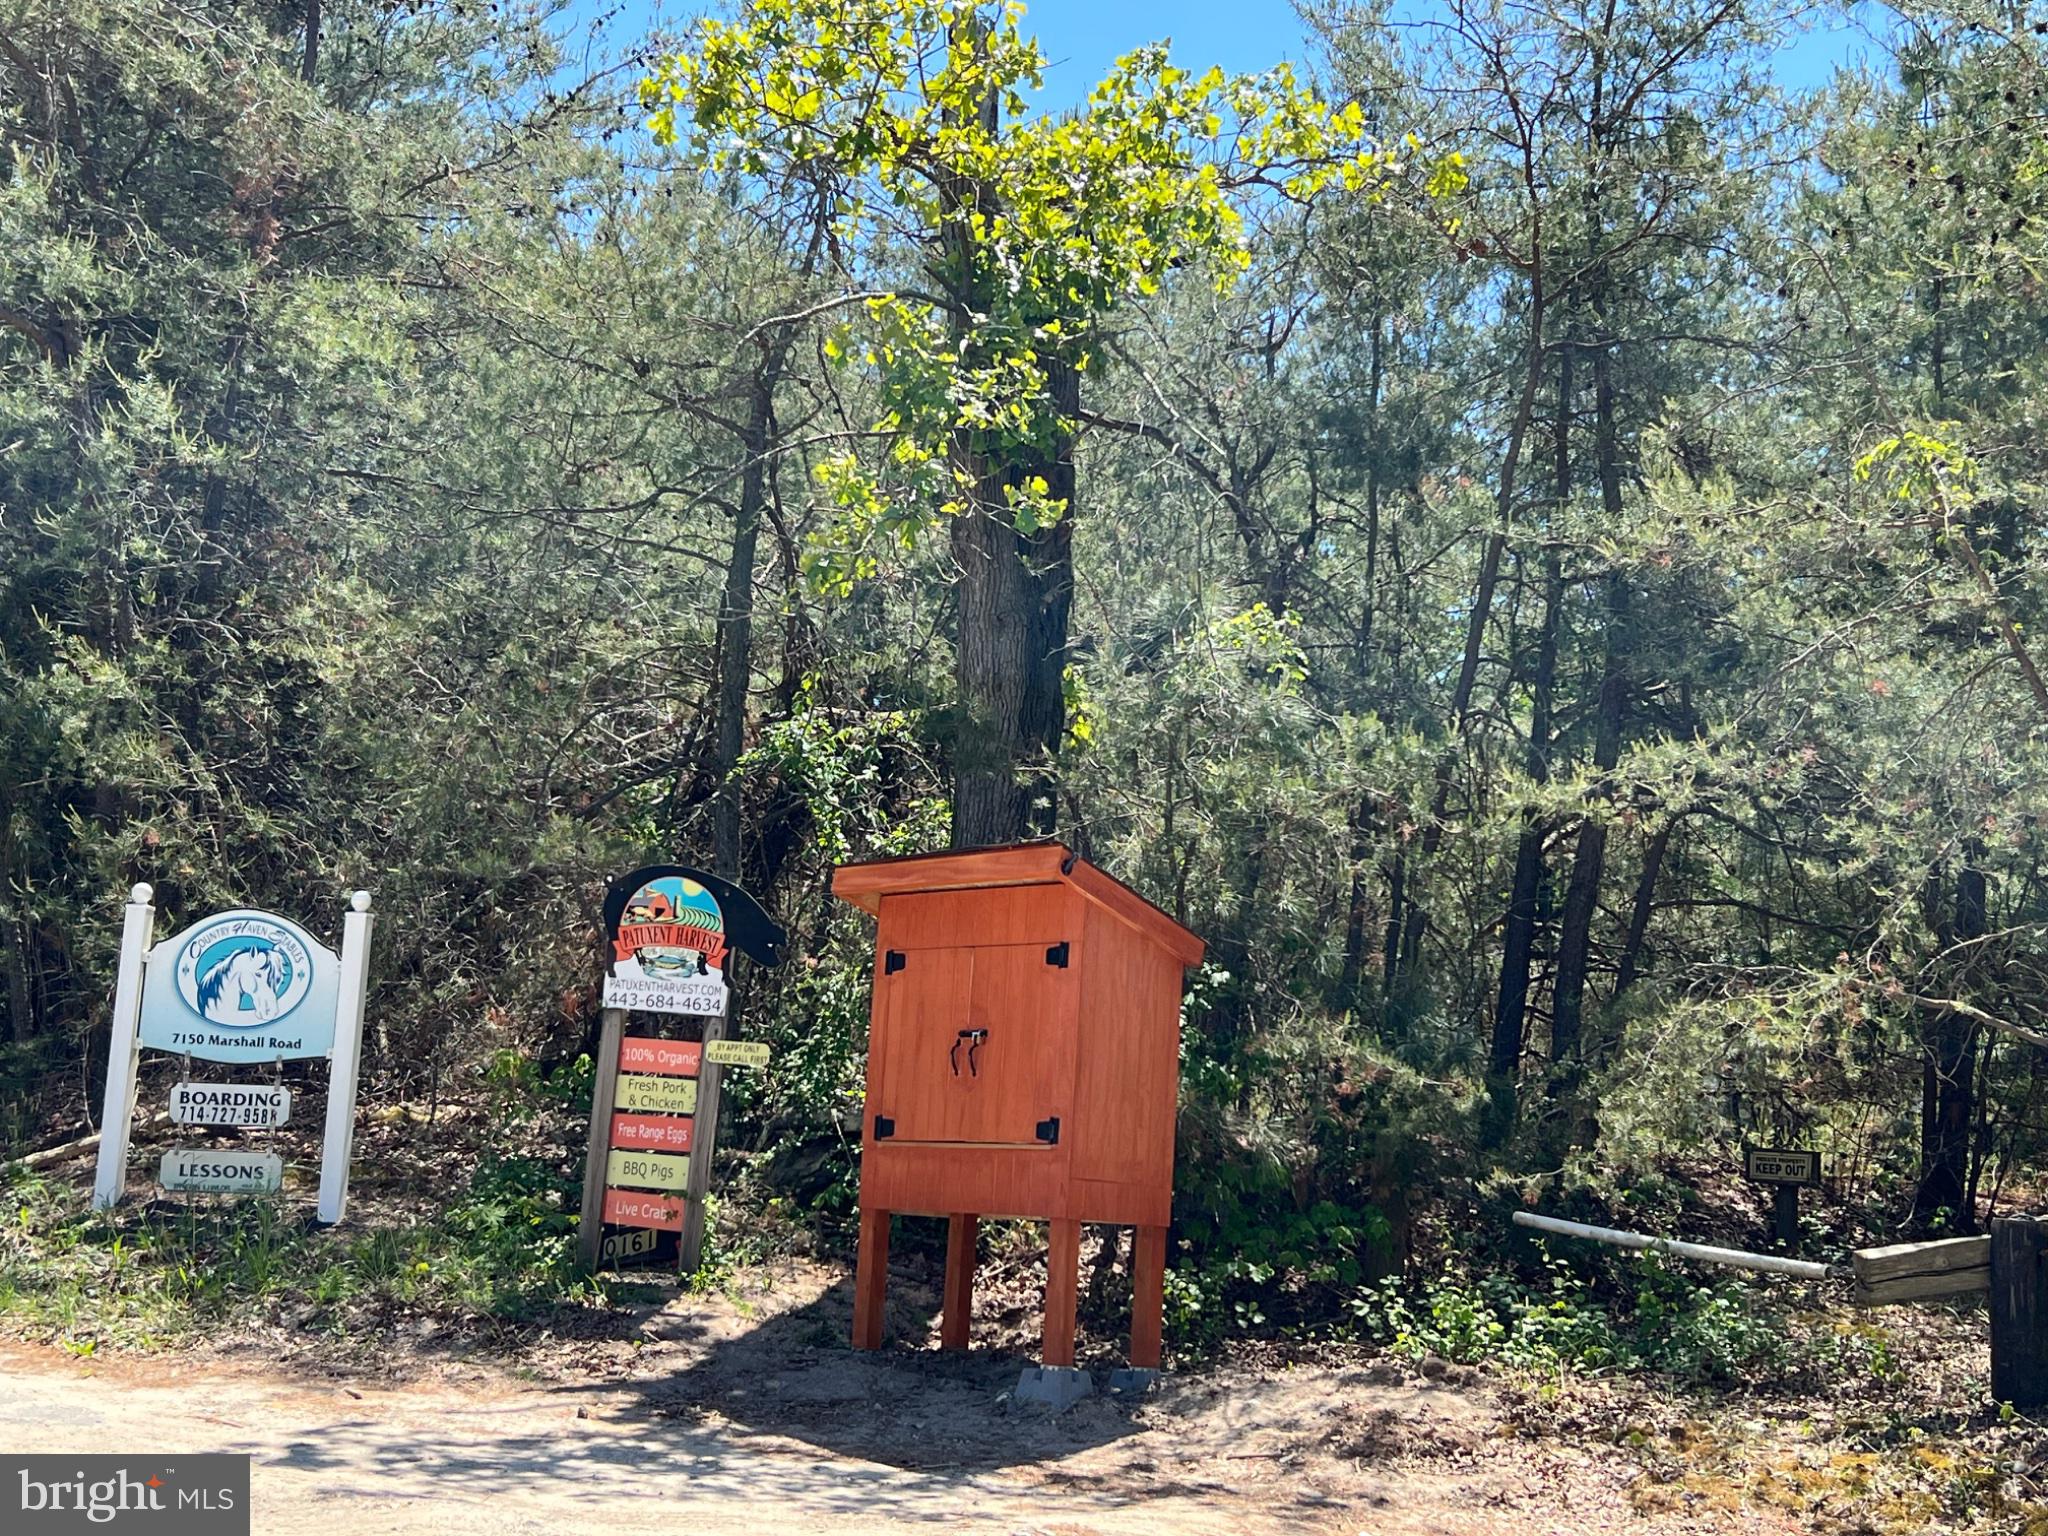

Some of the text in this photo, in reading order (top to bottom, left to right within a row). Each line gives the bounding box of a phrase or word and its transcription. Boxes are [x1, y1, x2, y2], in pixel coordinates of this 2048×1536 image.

[622, 926, 720, 954] PATUXENT HARVEST
[609, 979, 722, 996] PATUXENTHARVEST.COM
[608, 992, 720, 1012] 443-684-4634
[172, 1033, 302, 1049] 7150 Marshall Road
[625, 1048, 698, 1066] 100% Organic
[628, 1079, 687, 1095] Fresh Pork
[180, 1091, 281, 1107] BOARDING
[628, 1095, 684, 1110] & Chicken
[618, 1123, 688, 1143] Free Range Eggs
[179, 1163, 264, 1180] LESSONS
[623, 1161, 674, 1181] BBQ Pigs
[1756, 1162, 1806, 1176] KEEP OUT
[616, 1201, 677, 1220] Live Crab
[605, 1230, 653, 1256] 0161
